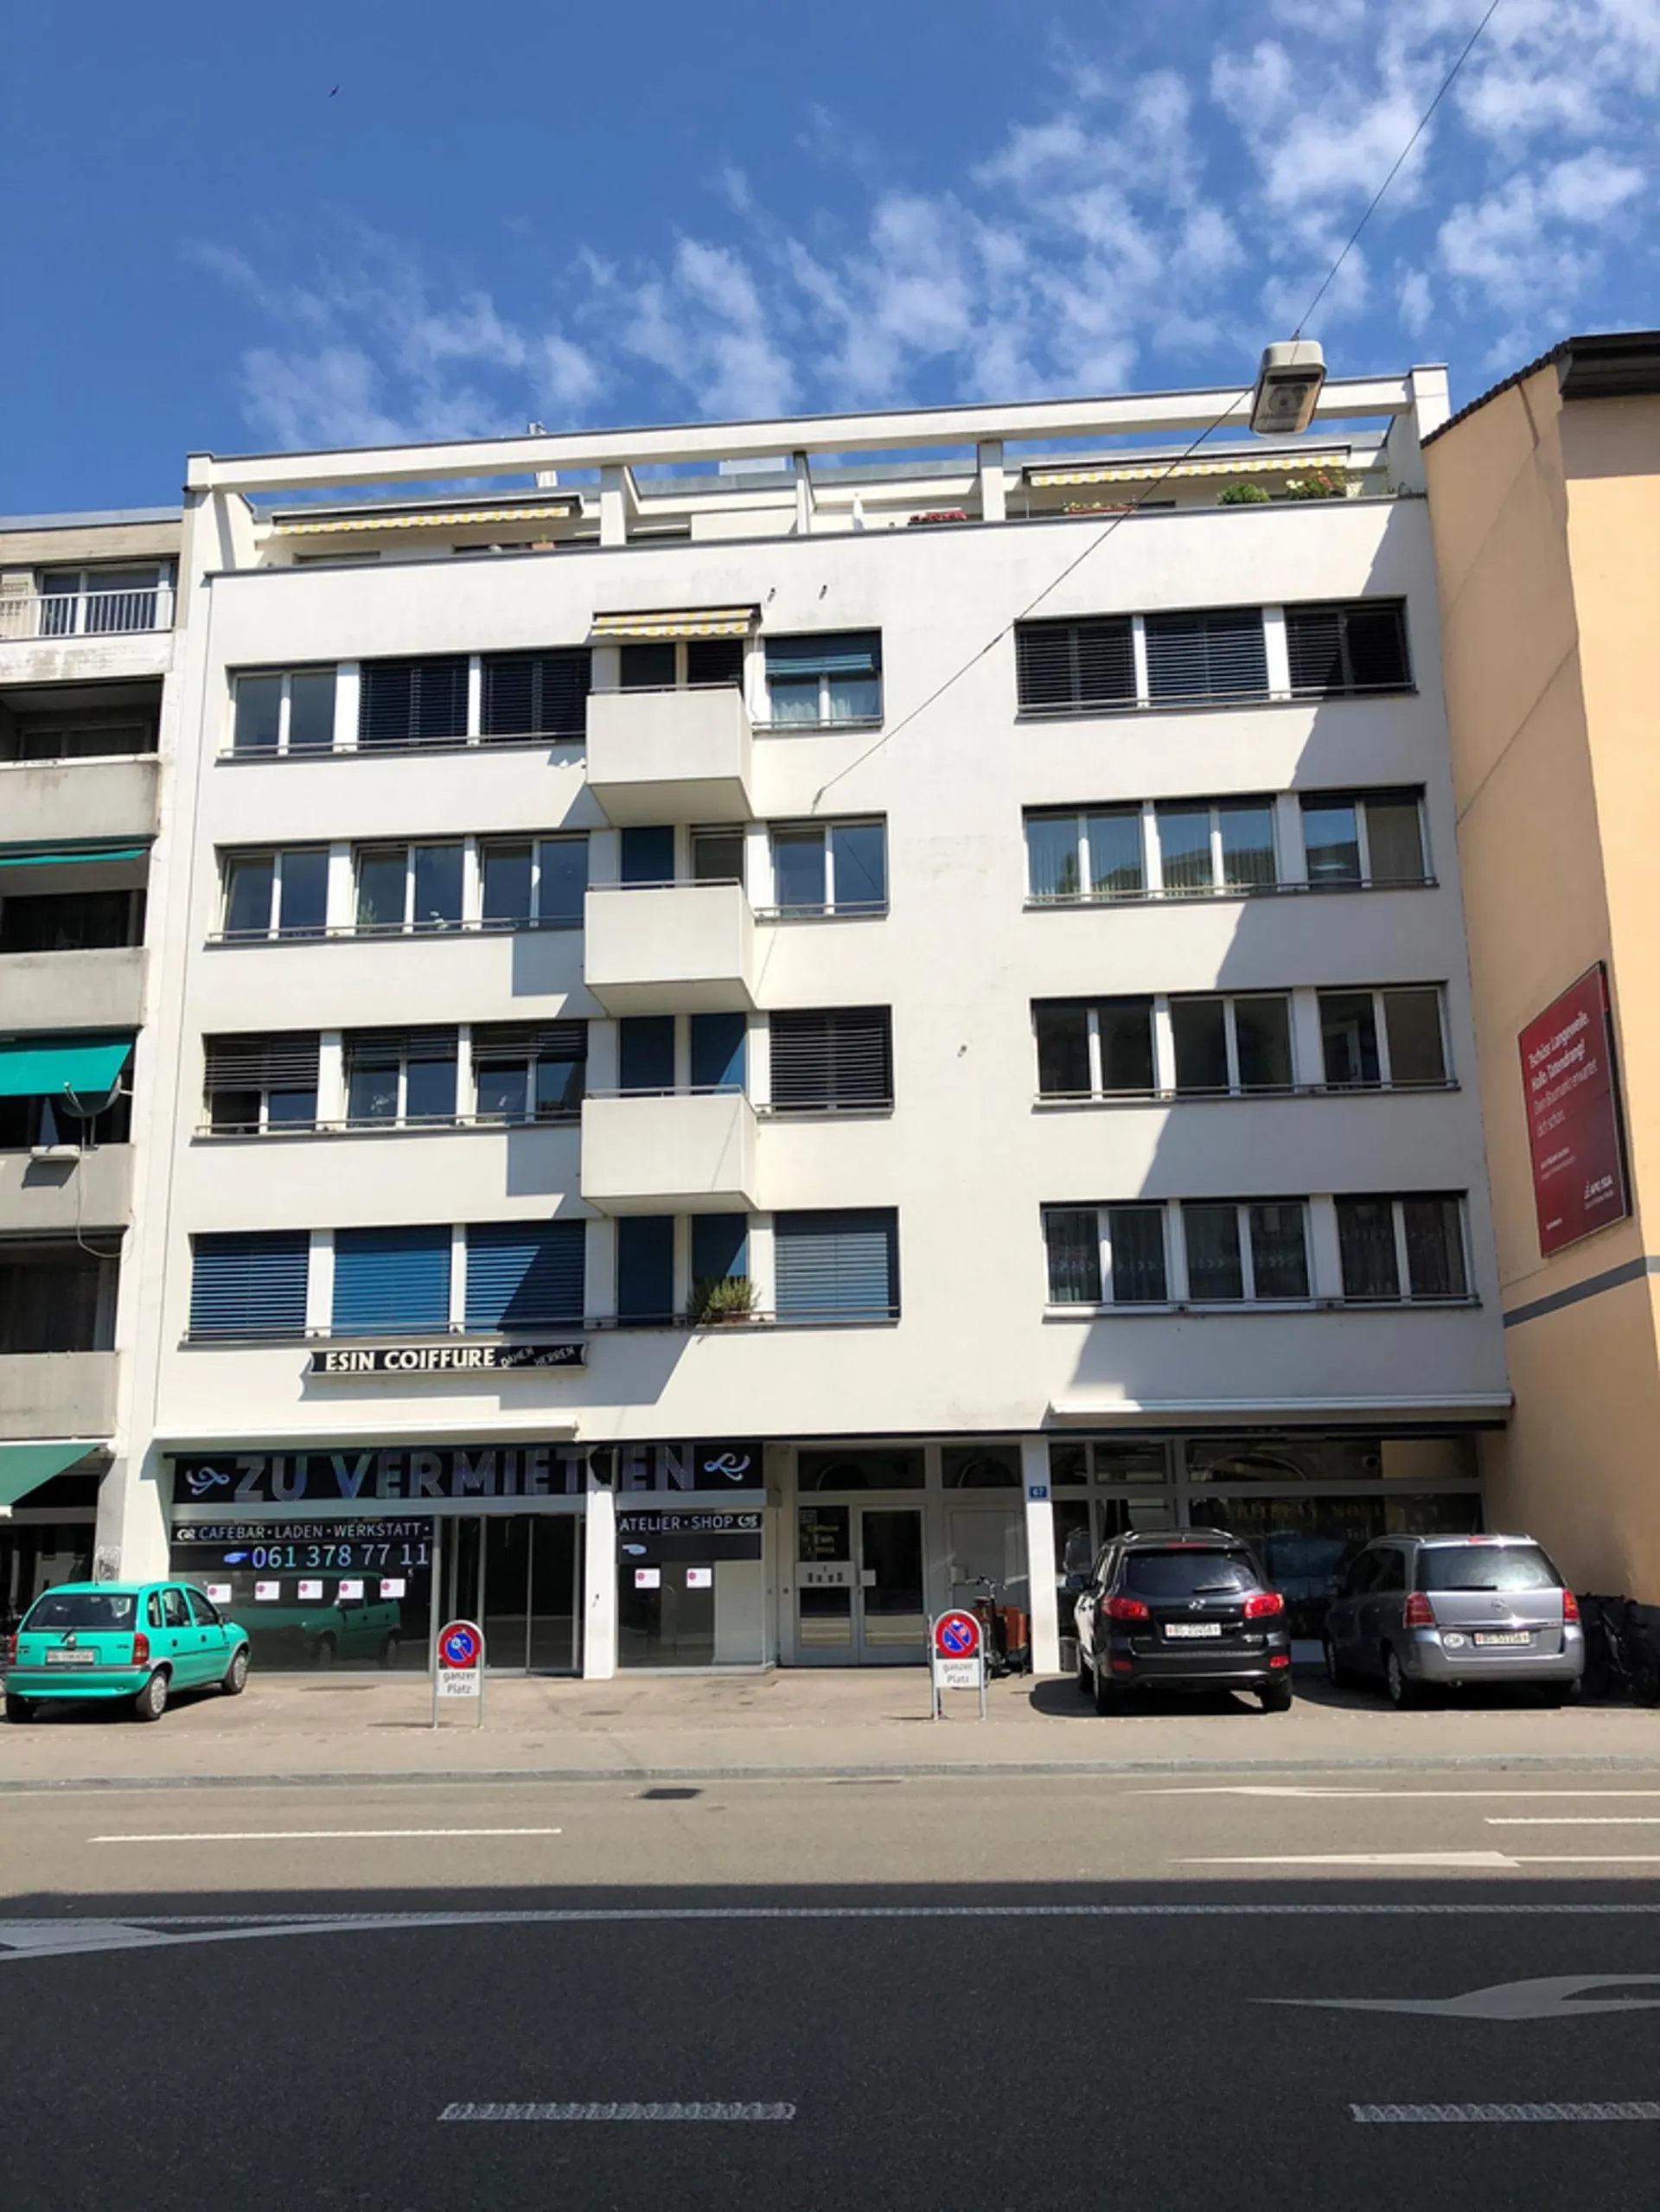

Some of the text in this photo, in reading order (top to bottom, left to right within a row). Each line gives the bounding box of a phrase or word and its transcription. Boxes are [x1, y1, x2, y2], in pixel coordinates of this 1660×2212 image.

[325, 1348, 495, 1371] ESIN COIFFURE
[234, 1444, 694, 1501] ZU VERMIETEN
[199, 1522, 421, 1539] CAFEBAR LADEN WERKSTATT
[619, 1515, 733, 1531] ATELIER SHOP
[252, 1543, 429, 1568] 061 378 77 11
[447, 1683, 471, 1693] Platz
